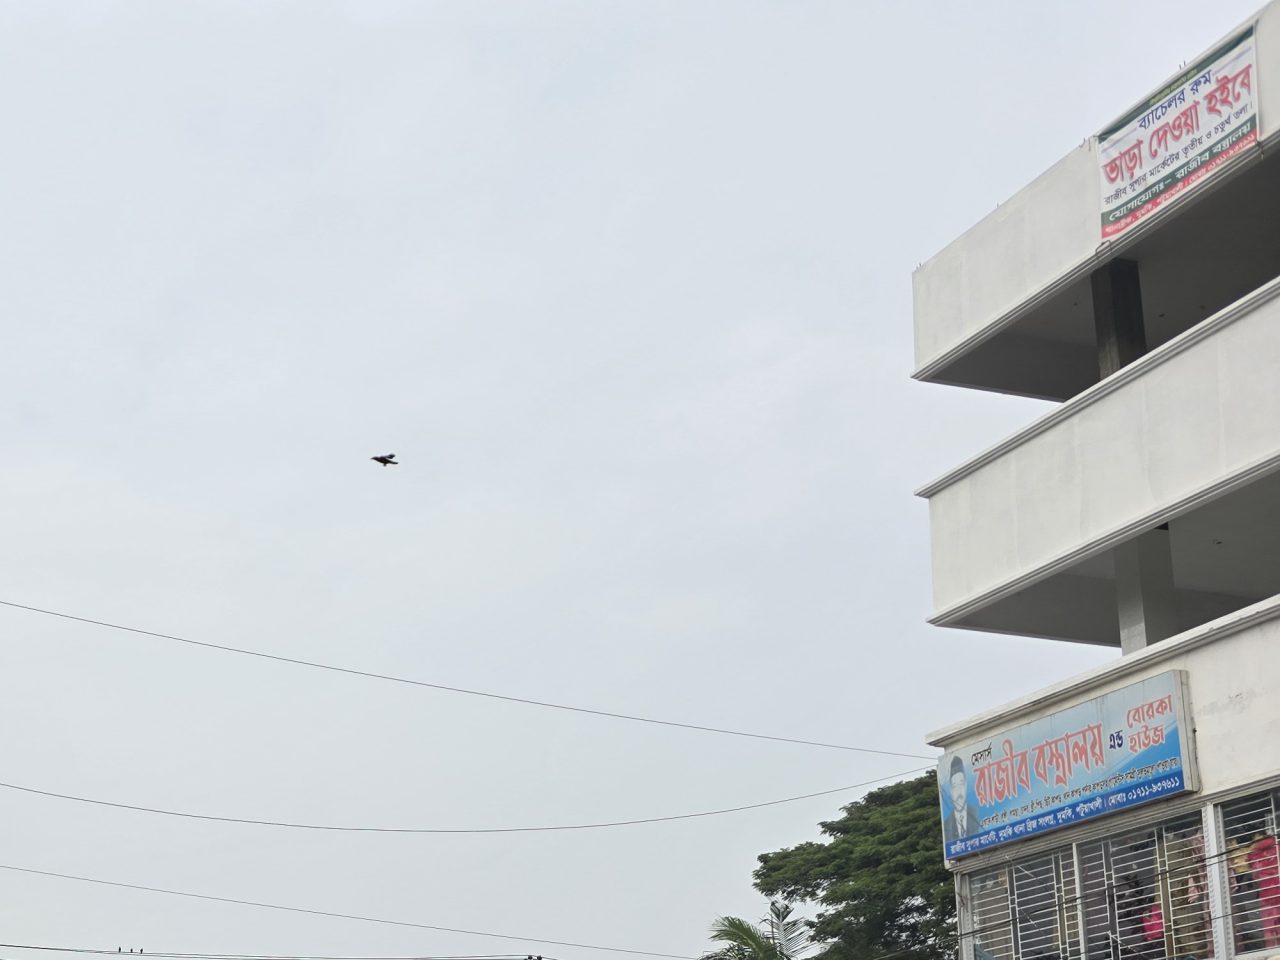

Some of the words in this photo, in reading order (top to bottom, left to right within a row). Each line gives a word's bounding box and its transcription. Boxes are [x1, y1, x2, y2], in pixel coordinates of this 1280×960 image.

[1137, 88, 1186, 130] ব্যাচেলর
[1190, 69, 1212, 95] রুম
[1101, 139, 1144, 184] ভাড়া
[1149, 99, 1200, 158] দেওয়া
[1204, 63, 1253, 117] হইবে
[1175, 150, 1210, 179] রাজীব
[1104, 186, 1127, 205] রাজীব
[1128, 173, 1147, 192] সুপার
[971, 742, 993, 766] মেসার্স
[973, 738, 1030, 807] রাজীব
[1032, 722, 1105, 788] বস্ত্রালয়
[1109, 730, 1124, 750] এন্ড
[1127, 695, 1173, 729] বোরকা
[1128, 723, 1166, 754] হাউজ
[1128, 777, 1180, 800] ০১৭১১-৯৩৭৬১১
